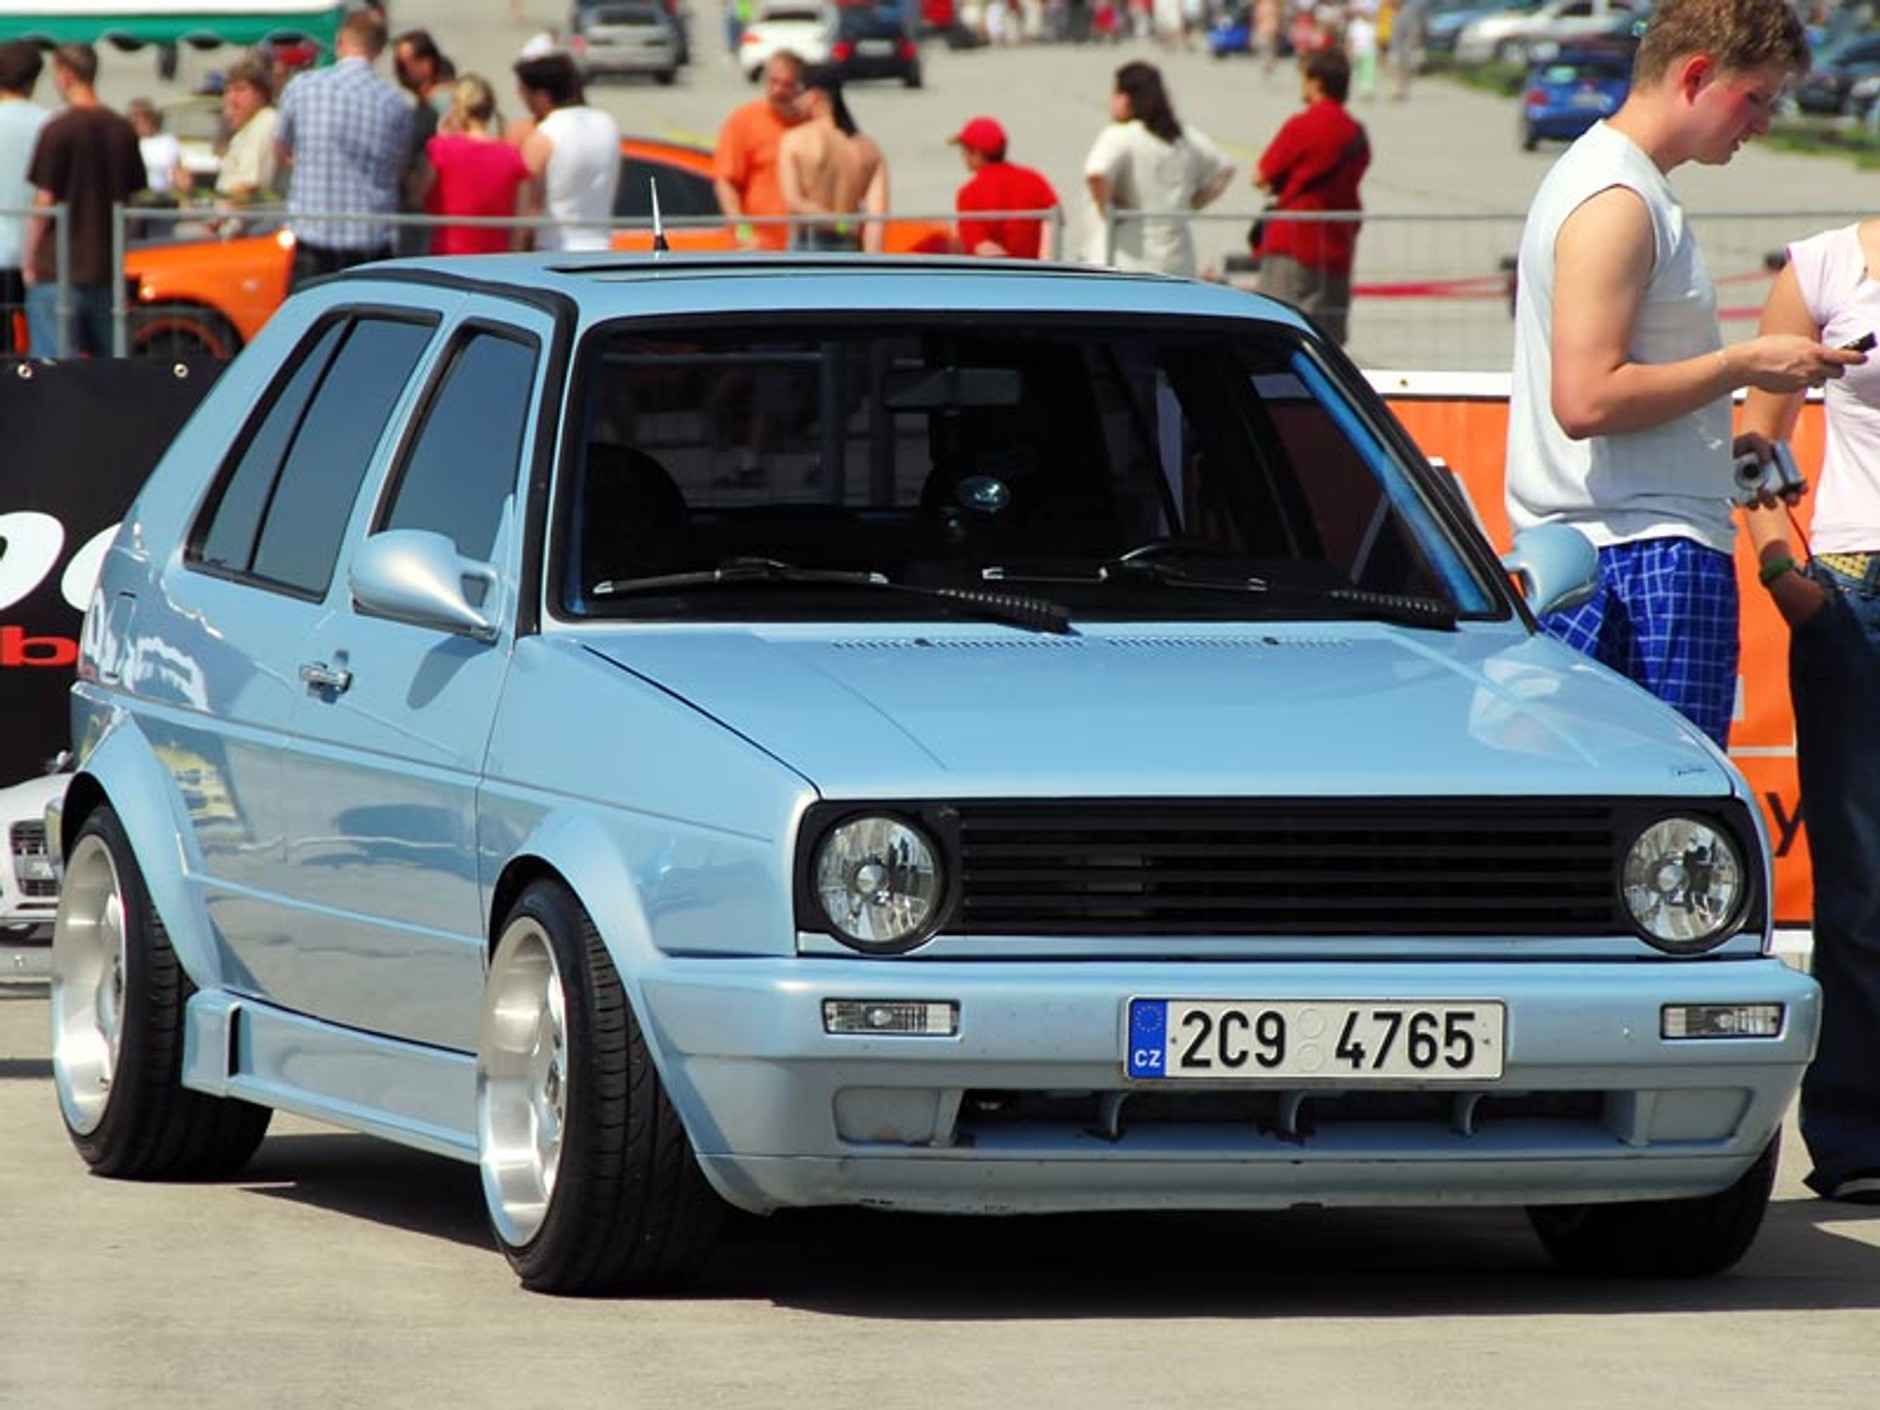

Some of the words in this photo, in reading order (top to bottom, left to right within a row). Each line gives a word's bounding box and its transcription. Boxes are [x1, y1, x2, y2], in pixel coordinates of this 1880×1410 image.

[1180, 1010, 1286, 1068] 2C9
[1335, 1011, 1476, 1069] 4765
[1134, 1050, 1161, 1068] CZ
